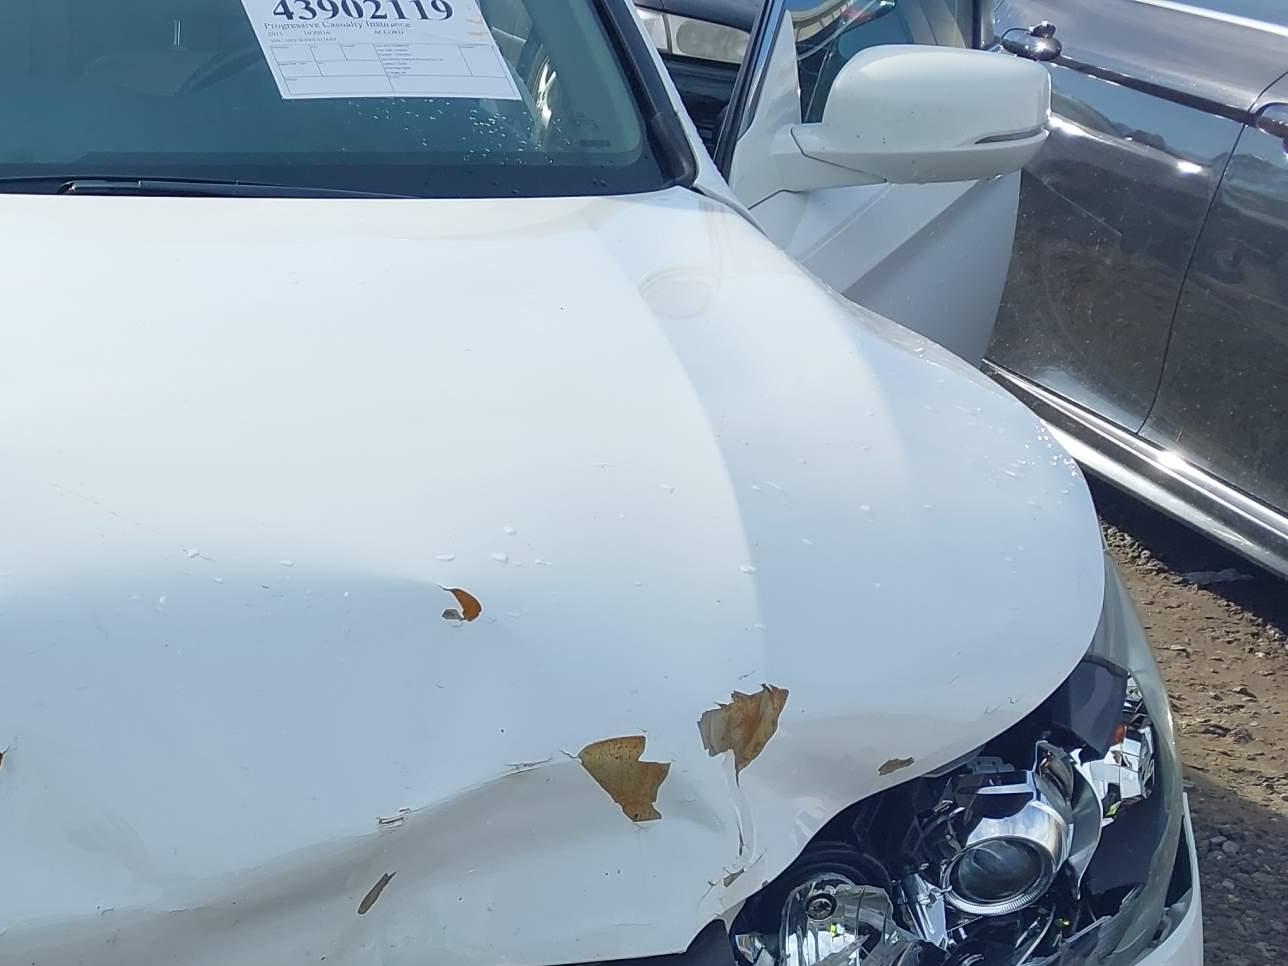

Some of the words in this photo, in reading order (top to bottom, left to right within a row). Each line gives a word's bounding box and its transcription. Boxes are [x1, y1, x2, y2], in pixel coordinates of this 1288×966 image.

[272, 0, 454, 20] 43902119
[264, 21, 320, 30] Progressive
[322, 20, 363, 29] Casualty
[365, 20, 411, 28] Insurance
